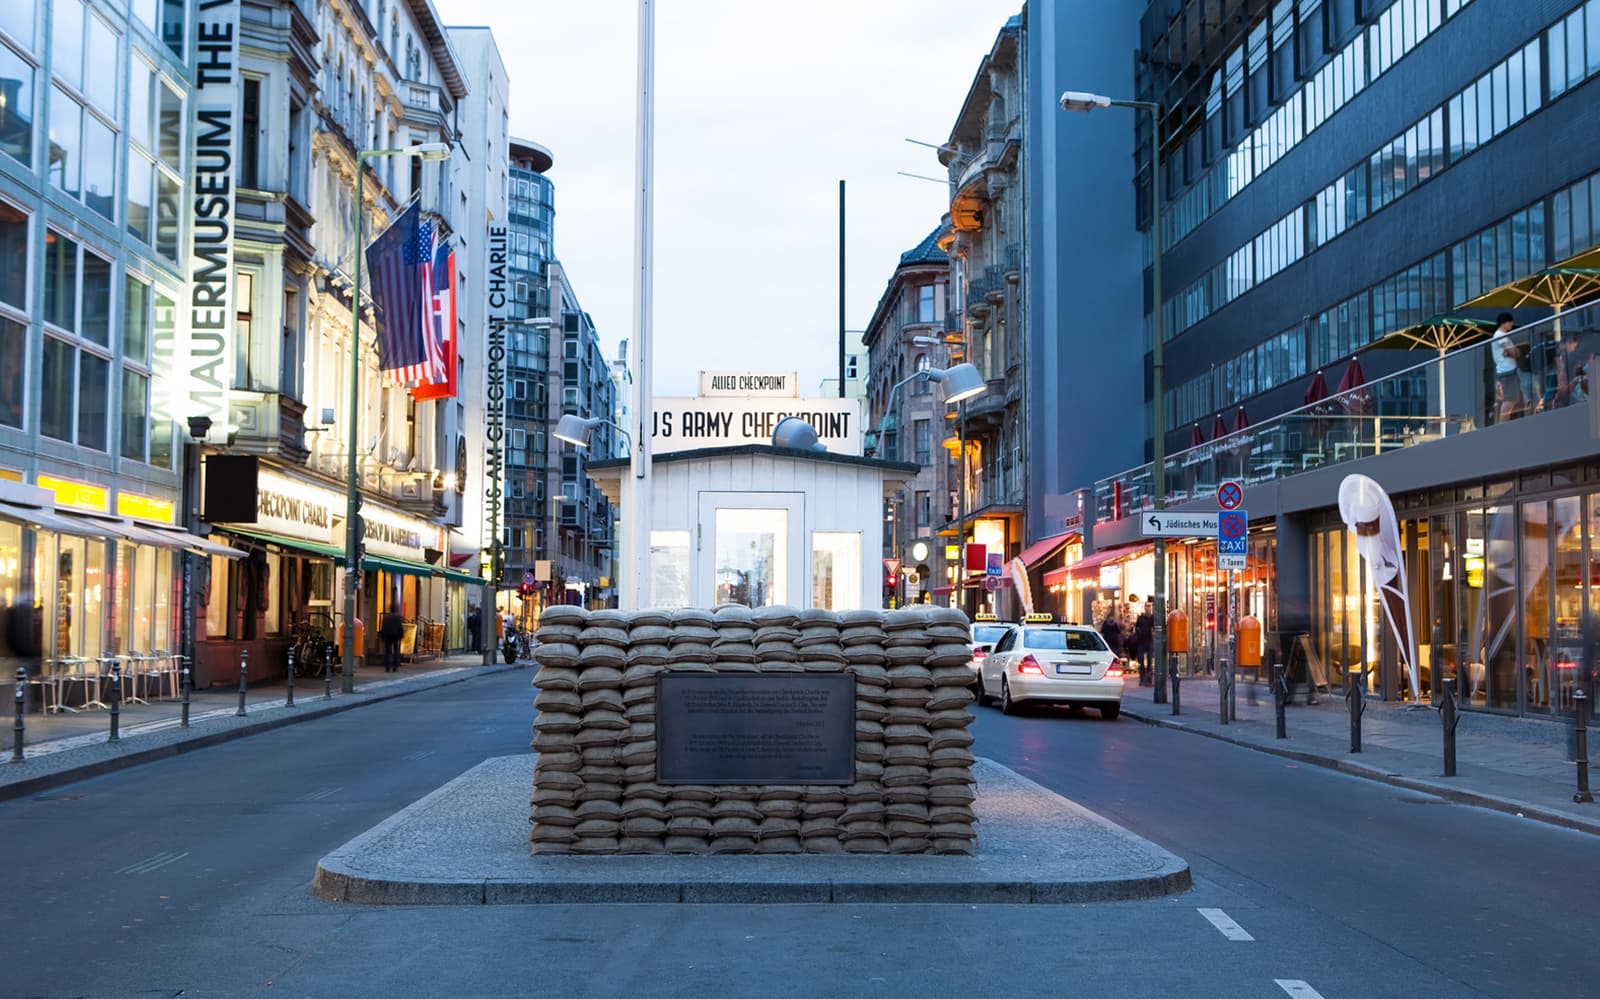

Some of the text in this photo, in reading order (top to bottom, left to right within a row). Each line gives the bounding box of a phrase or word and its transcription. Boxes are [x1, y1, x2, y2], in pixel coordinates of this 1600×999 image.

[197, 22, 233, 89] THE
[488, 227, 507, 308] CHARLIE
[486, 314, 506, 441] CHECKPOINT
[711, 375, 786, 390] ALLIED CHECKPOINT
[682, 411, 733, 438] ARMY
[742, 411, 852, 438] CHEOINT
[486, 449, 503, 481] AM
[1165, 519, 1201, 529] Jüdisches
[1220, 540, 1245, 551] TAXI
